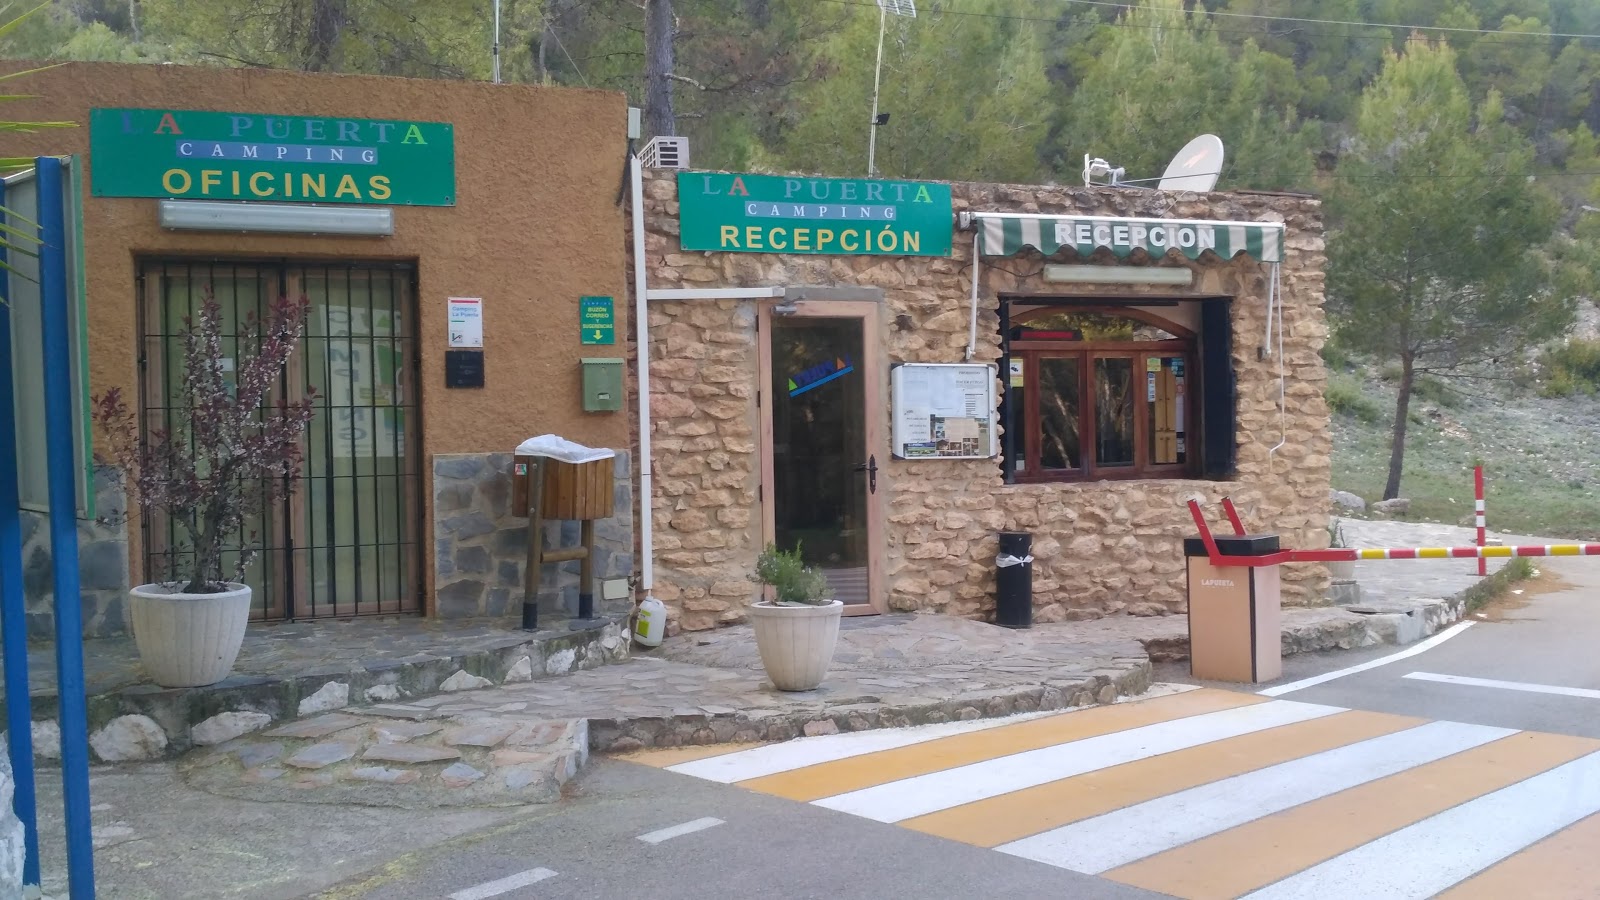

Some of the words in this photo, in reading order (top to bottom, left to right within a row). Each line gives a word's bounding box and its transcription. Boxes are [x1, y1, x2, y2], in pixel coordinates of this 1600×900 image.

[120, 112, 183, 135] LA
[229, 116, 428, 145] PUERTA
[180, 143, 375, 162] CAMPING
[162, 168, 392, 200] OFICINAS
[702, 175, 750, 196] LA
[784, 180, 933, 203] PUERTA
[747, 203, 894, 219] CAMPING
[720, 224, 920, 252] RECEPCIÓN
[1054, 223, 1216, 249] RECEPCION
